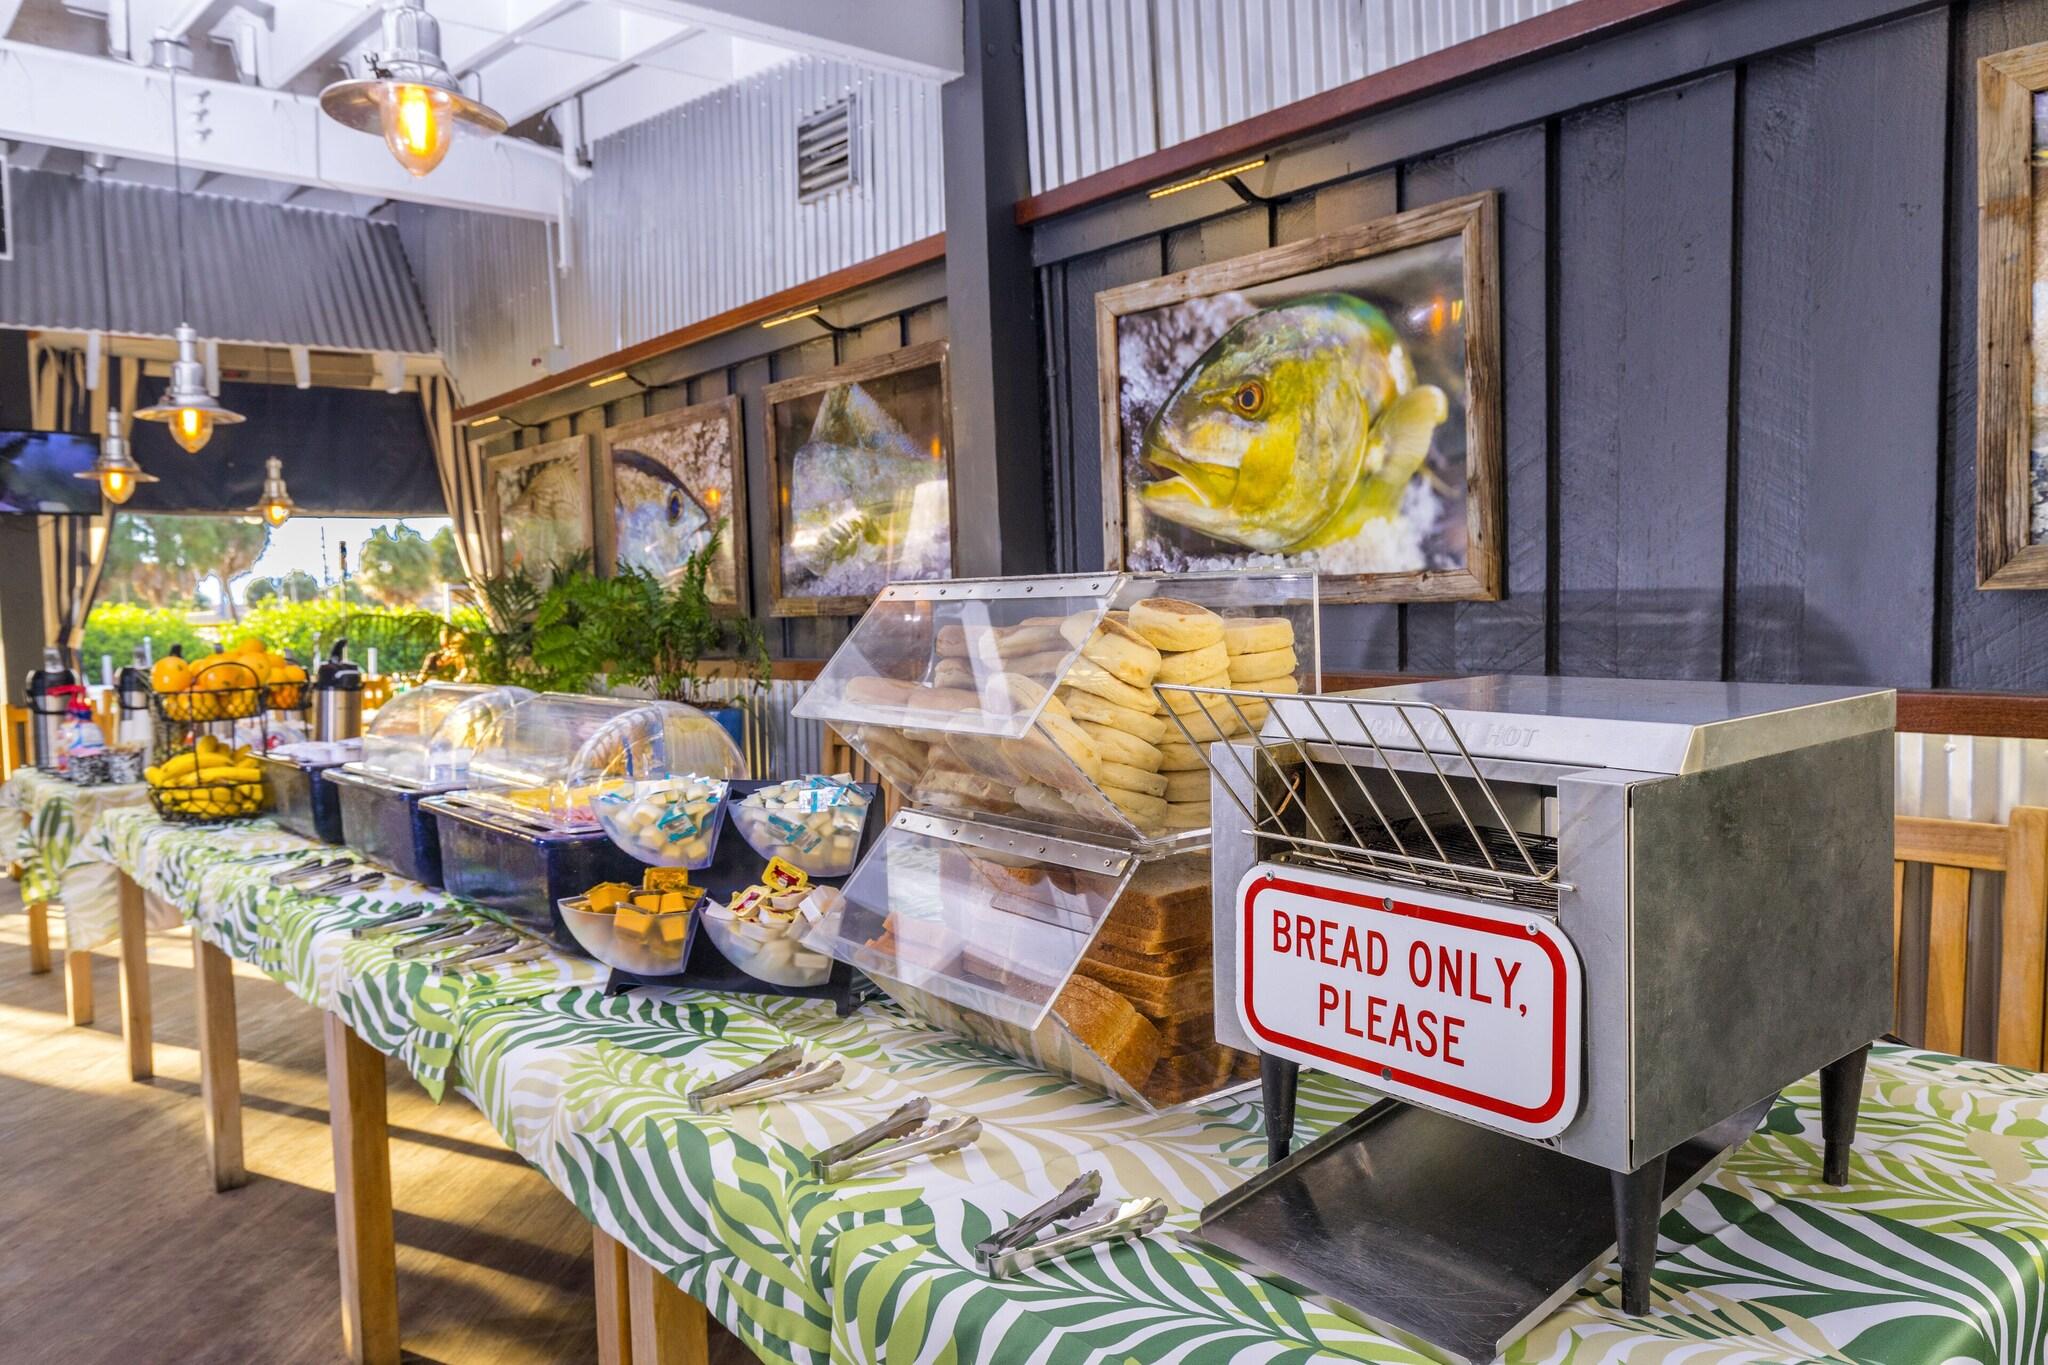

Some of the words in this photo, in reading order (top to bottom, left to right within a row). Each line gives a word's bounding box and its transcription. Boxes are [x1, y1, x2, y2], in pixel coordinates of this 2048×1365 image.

[1486, 723, 1540, 748] HOT
[1272, 909, 1389, 977] BREAD
[1408, 940, 1528, 1018] ONLY,
[1318, 983, 1466, 1067] PLEASE
